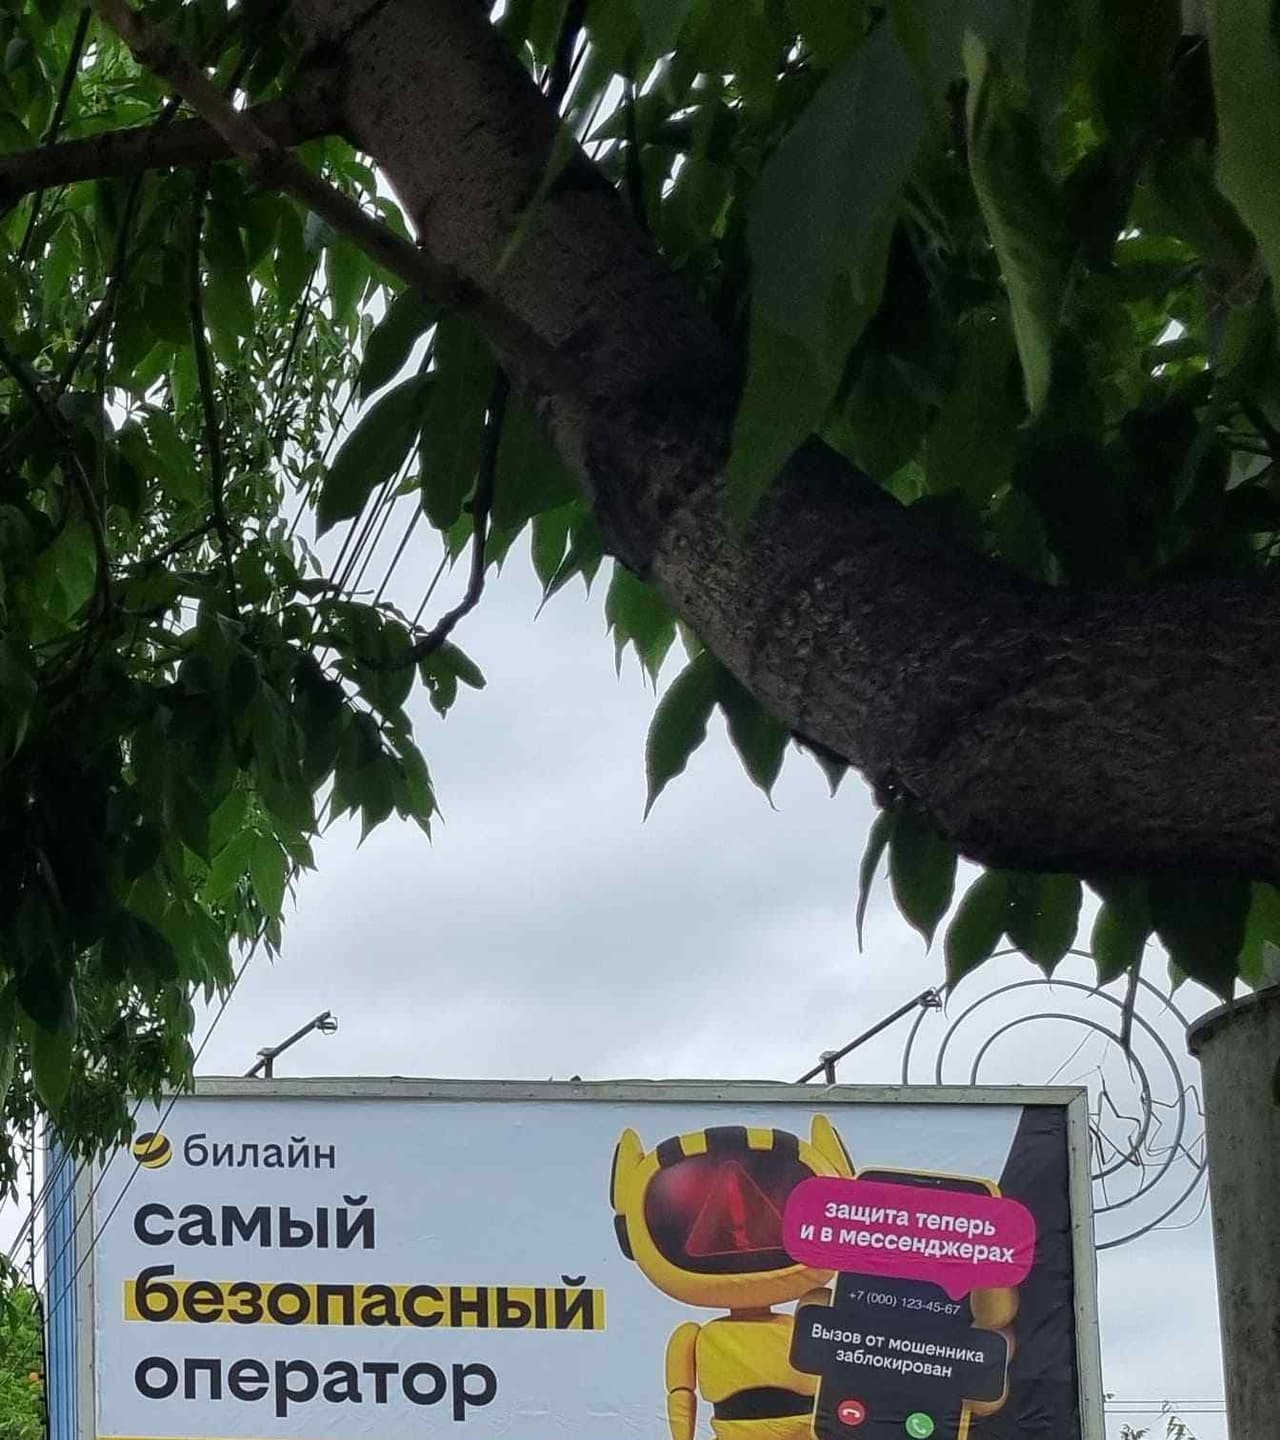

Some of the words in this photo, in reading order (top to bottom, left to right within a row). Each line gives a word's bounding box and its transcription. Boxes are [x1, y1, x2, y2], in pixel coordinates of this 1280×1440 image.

[184, 1133, 335, 1169] билайн
[134, 1195, 375, 1249] самый
[825, 1202, 908, 1226] защита
[916, 1213, 995, 1238] теперь
[801, 1225, 814, 1240] и
[821, 1227, 832, 1242] в
[840, 1229, 1014, 1264] мессенджерах
[135, 1264, 594, 1329] безопасный
[849, 1291, 864, 1302] +7
[867, 1292, 897, 1306] (000)
[902, 1297, 960, 1315] 123-45-67
[812, 1324, 860, 1345] Вызов
[866, 1335, 885, 1348] от
[889, 1337, 983, 1363] мошенника
[836, 1349, 952, 1378] заблокирован
[135, 1356, 497, 1421] оператор
